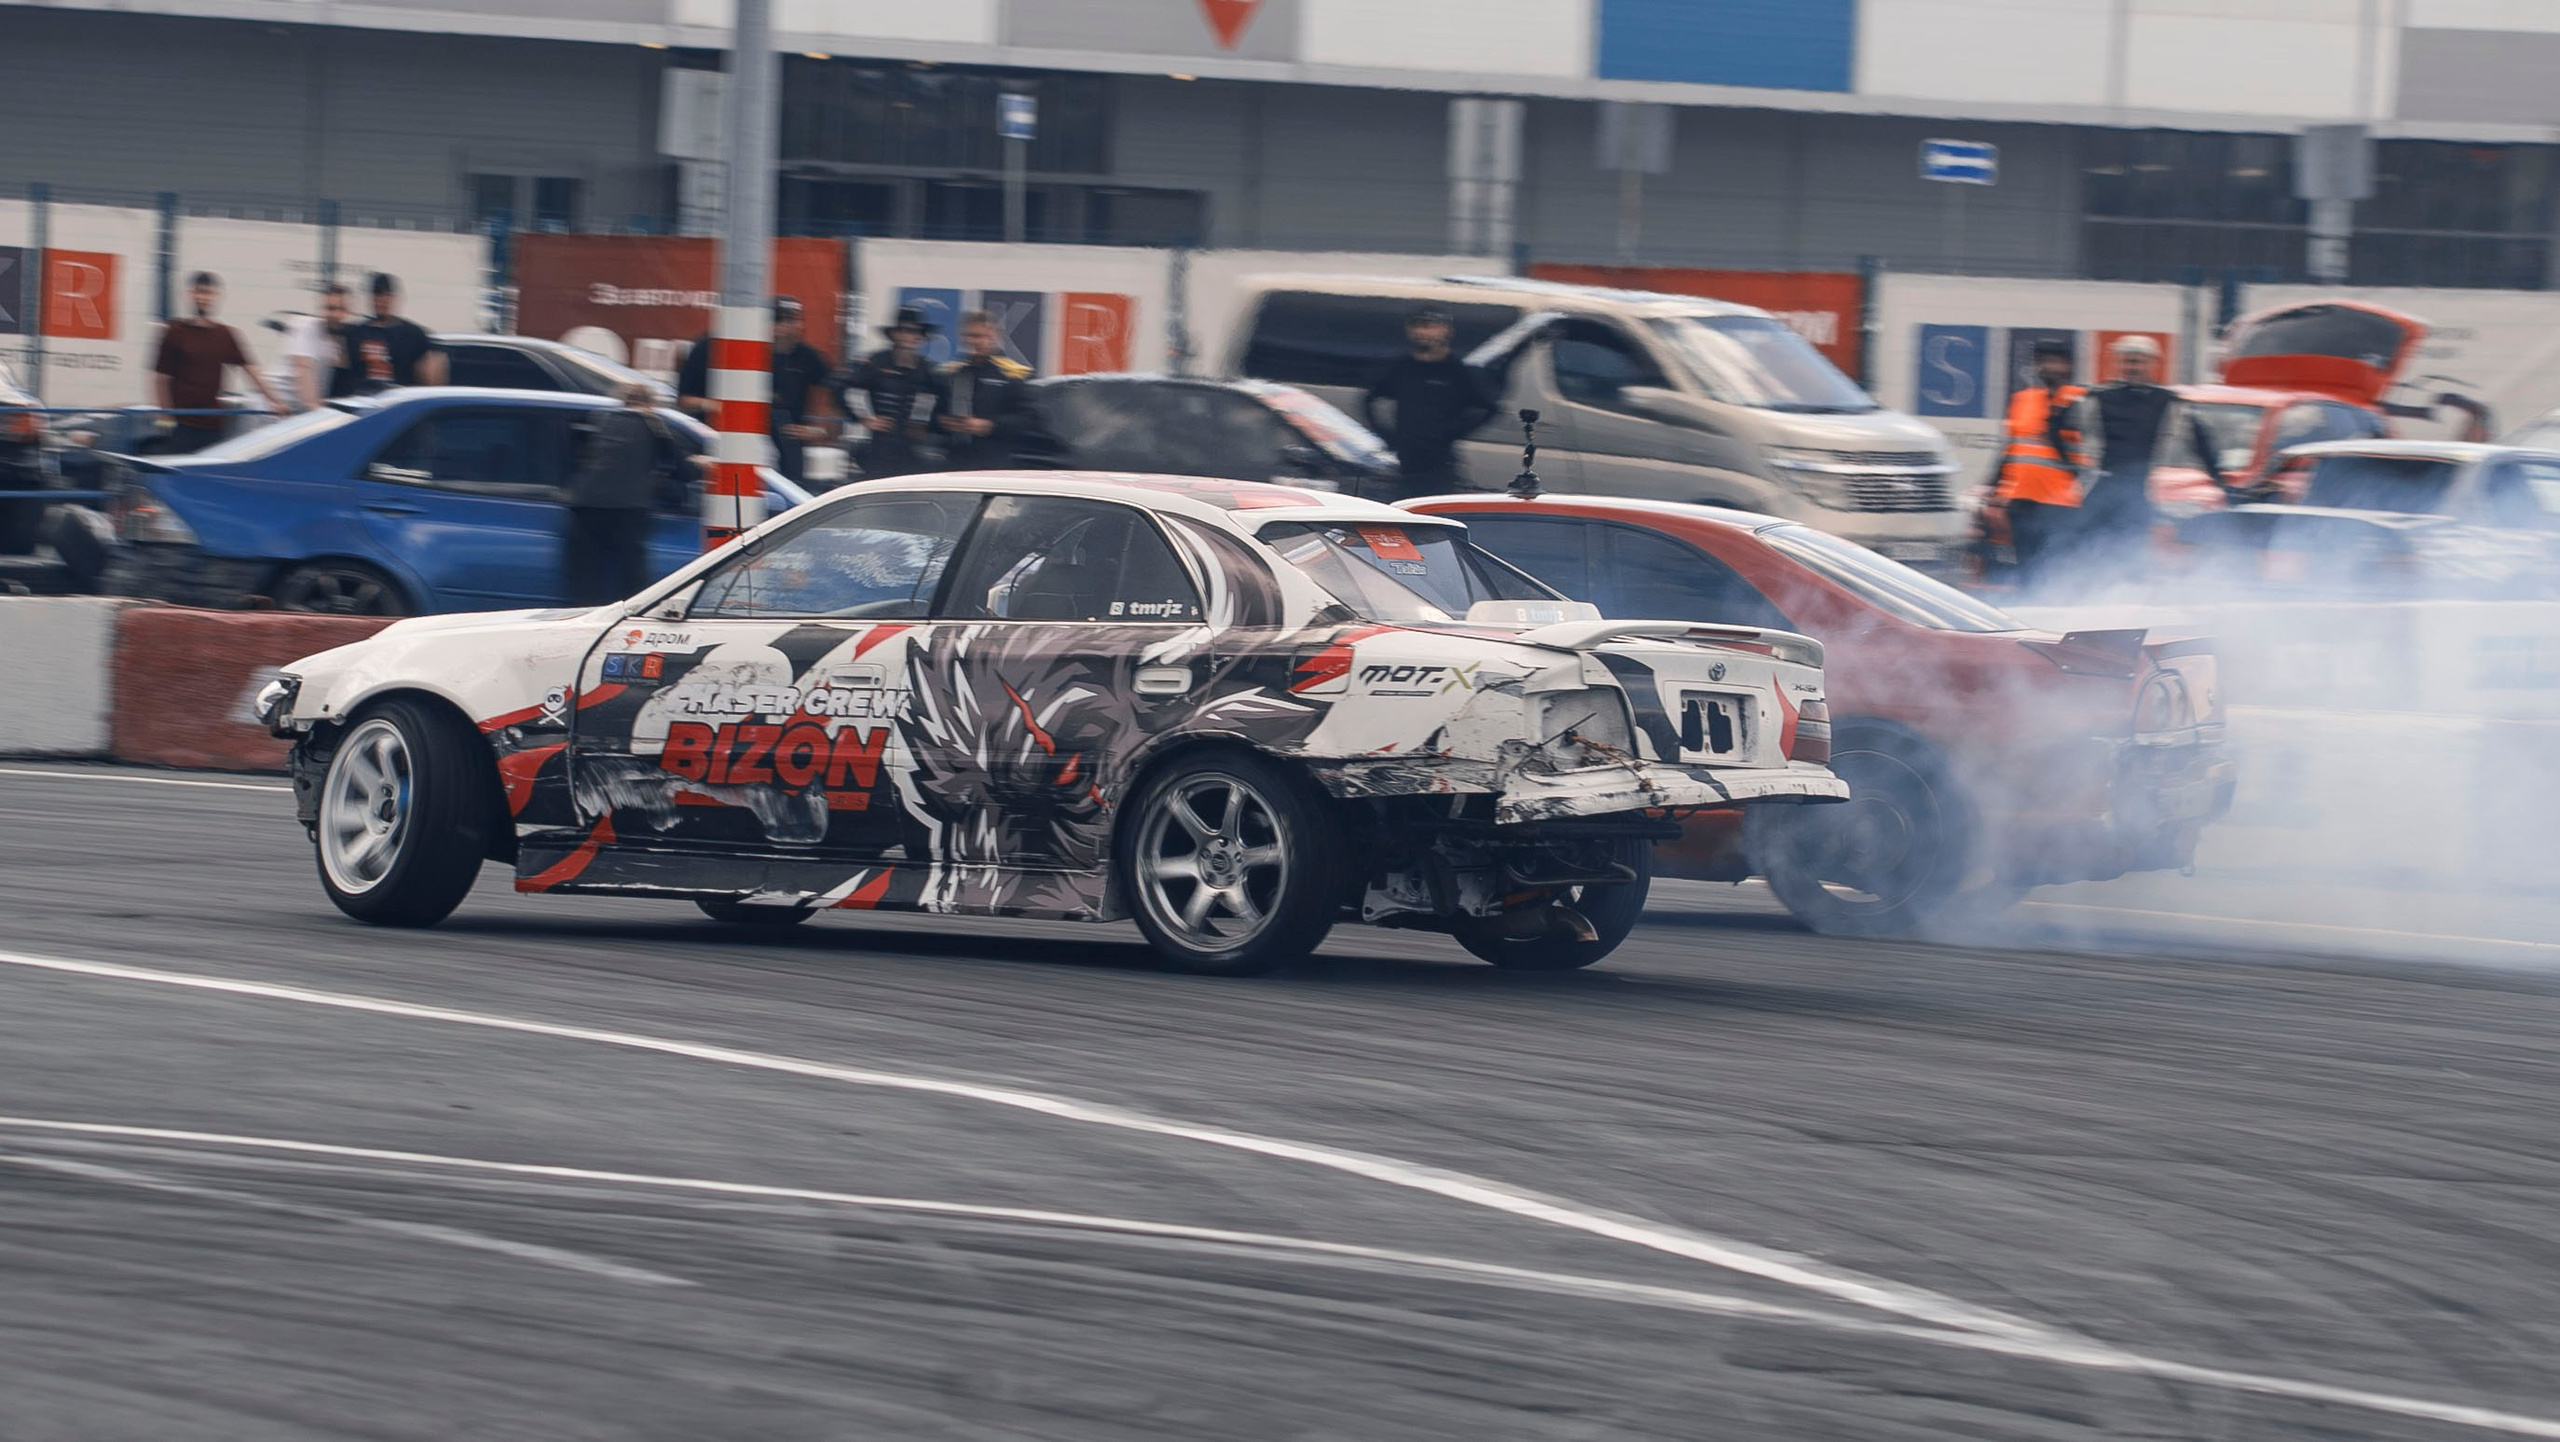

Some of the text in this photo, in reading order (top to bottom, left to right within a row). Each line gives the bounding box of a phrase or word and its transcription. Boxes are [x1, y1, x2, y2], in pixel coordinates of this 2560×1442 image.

[1129, 599, 1183, 618] tmrjz
[605, 655, 660, 675] SKR
[803, 686, 908, 718] CREW
[660, 721, 890, 788] BIZON
